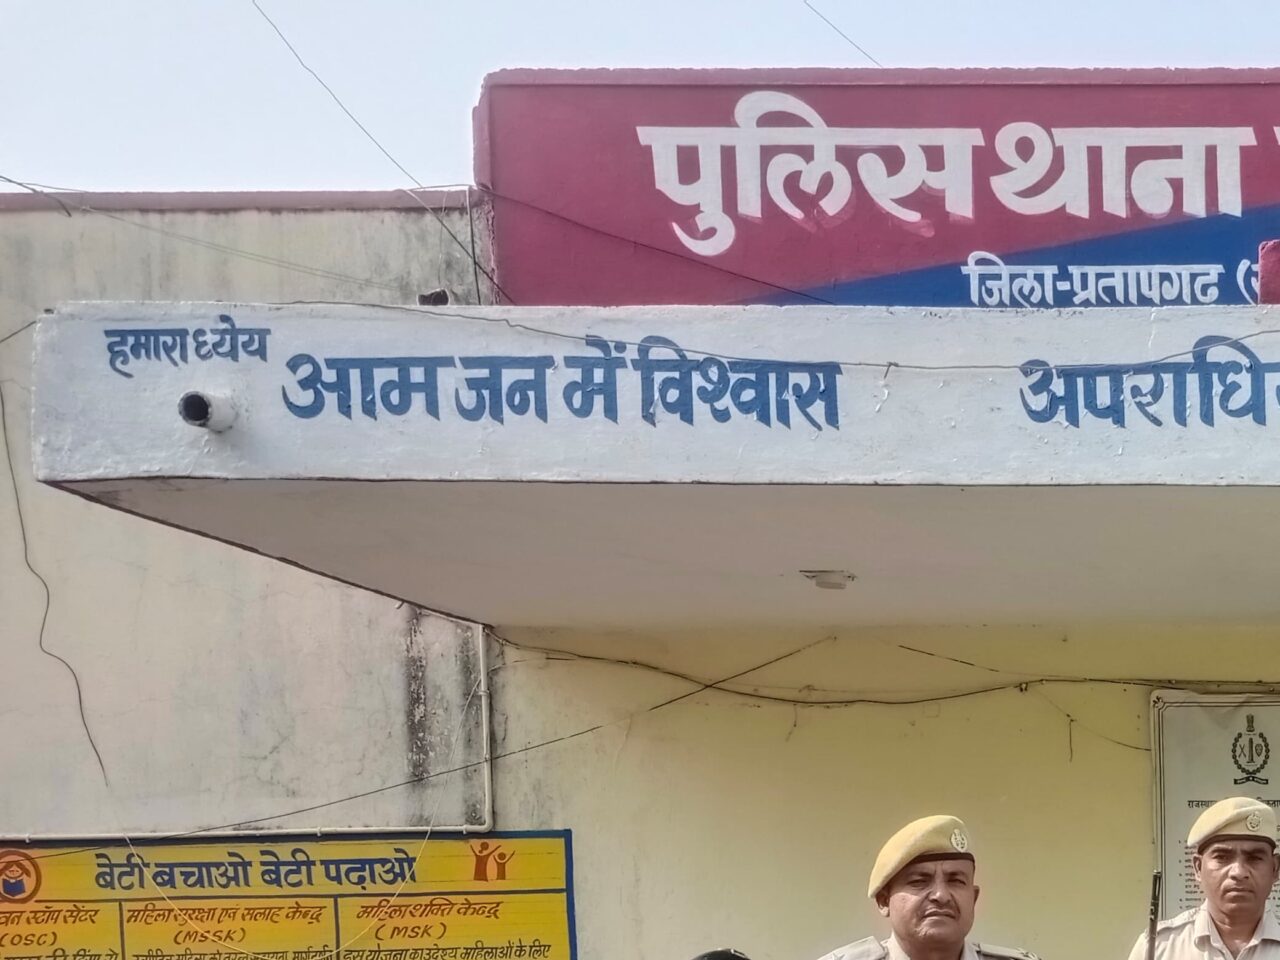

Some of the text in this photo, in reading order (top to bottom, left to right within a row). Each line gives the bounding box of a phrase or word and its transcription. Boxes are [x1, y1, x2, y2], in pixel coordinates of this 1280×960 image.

[636, 90, 985, 257] पुलिस
[988, 121, 1257, 219] थाना
[104, 314, 272, 378] हमारा ध्येय
[281, 334, 843, 431] आम जन में विश्वास
[94, 848, 417, 891] बेटी बचाओ बेटी पढ़ाओ
[27, 905, 63, 925] स्टॉप
[63, 904, 100, 924] सेंटर
[127, 903, 174, 925] महिला
[241, 907, 285, 924] सलाह
[514, 938, 528, 958] के
[528, 939, 552, 959] लिए
